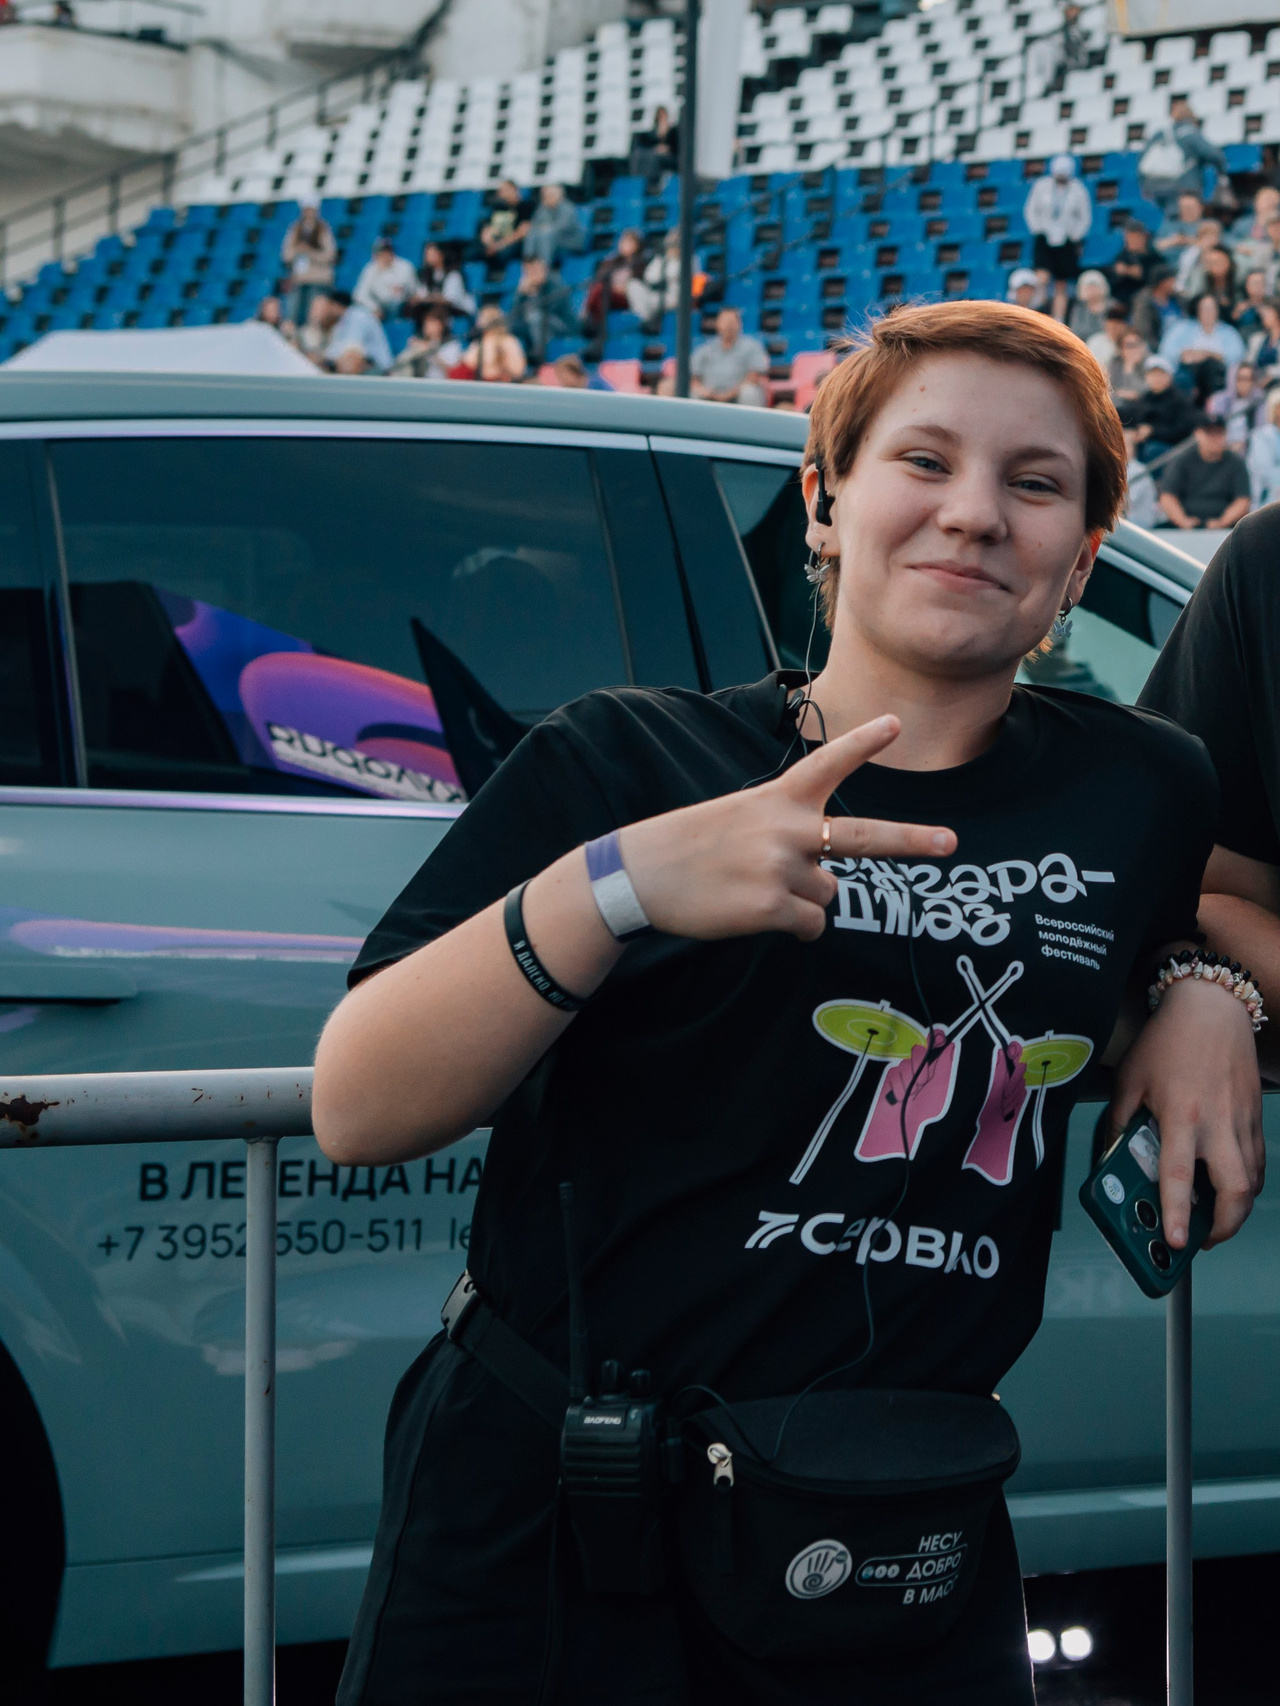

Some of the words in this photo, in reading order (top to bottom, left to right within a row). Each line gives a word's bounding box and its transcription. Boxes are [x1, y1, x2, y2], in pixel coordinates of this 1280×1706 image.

[1034, 913, 1115, 943] Всероссийский
[513, 940, 527, 951] Я
[1038, 930, 1107, 956] молодёжный
[1041, 944, 1101, 970] фестиваль
[138, 1162, 169, 1202] В
[180, 1158, 411, 1203] ЛЕЕНДА
[97, 1226, 145, 1261] +7
[917, 1531, 963, 1553] НЕСУ
[905, 1551, 962, 1582] ДОБРО
[902, 1588, 916, 1605] В
